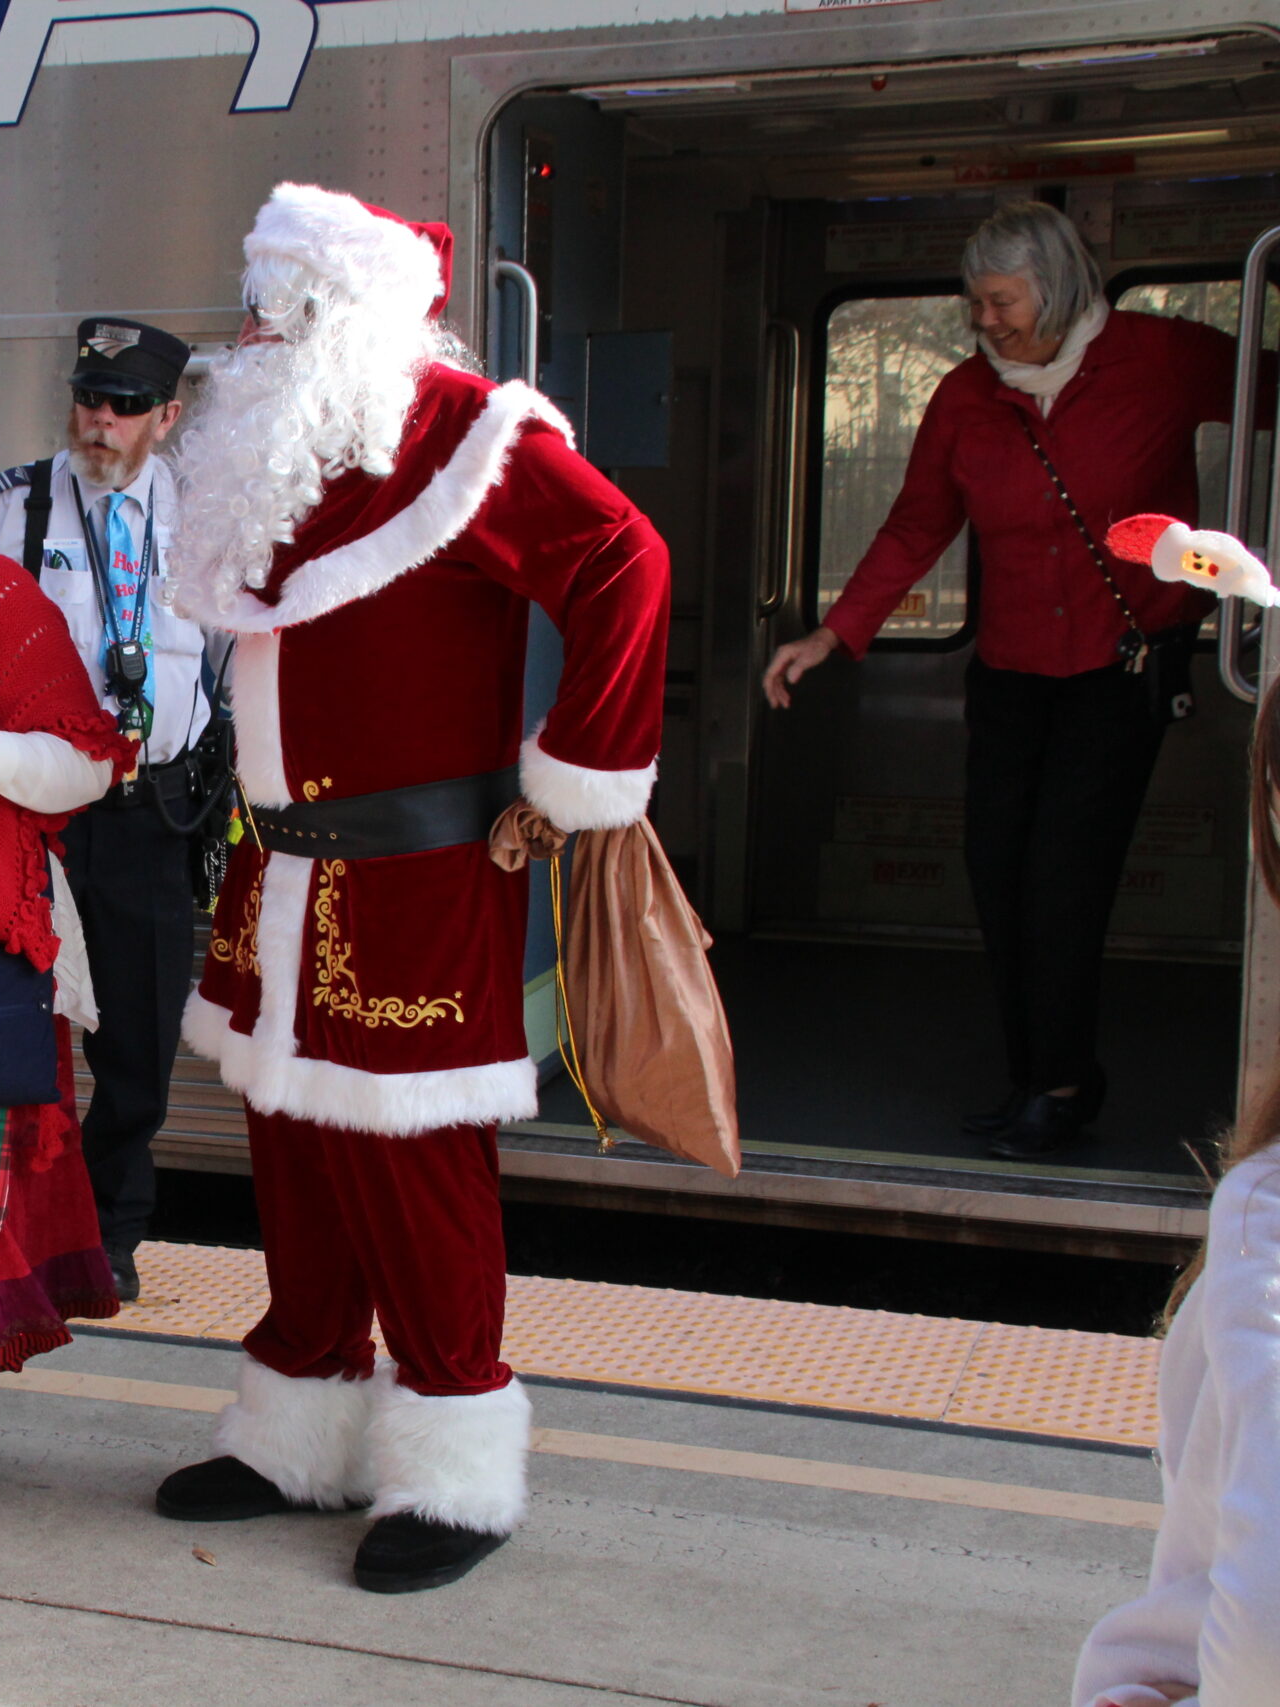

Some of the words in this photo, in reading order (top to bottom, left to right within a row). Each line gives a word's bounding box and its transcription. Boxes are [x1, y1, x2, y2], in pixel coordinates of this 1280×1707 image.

[112, 550, 140, 576] Ho!
[141, 539, 150, 573] AMTRAK
[114, 583, 138, 597] Ho!
[897, 862, 941, 880] EXIT
